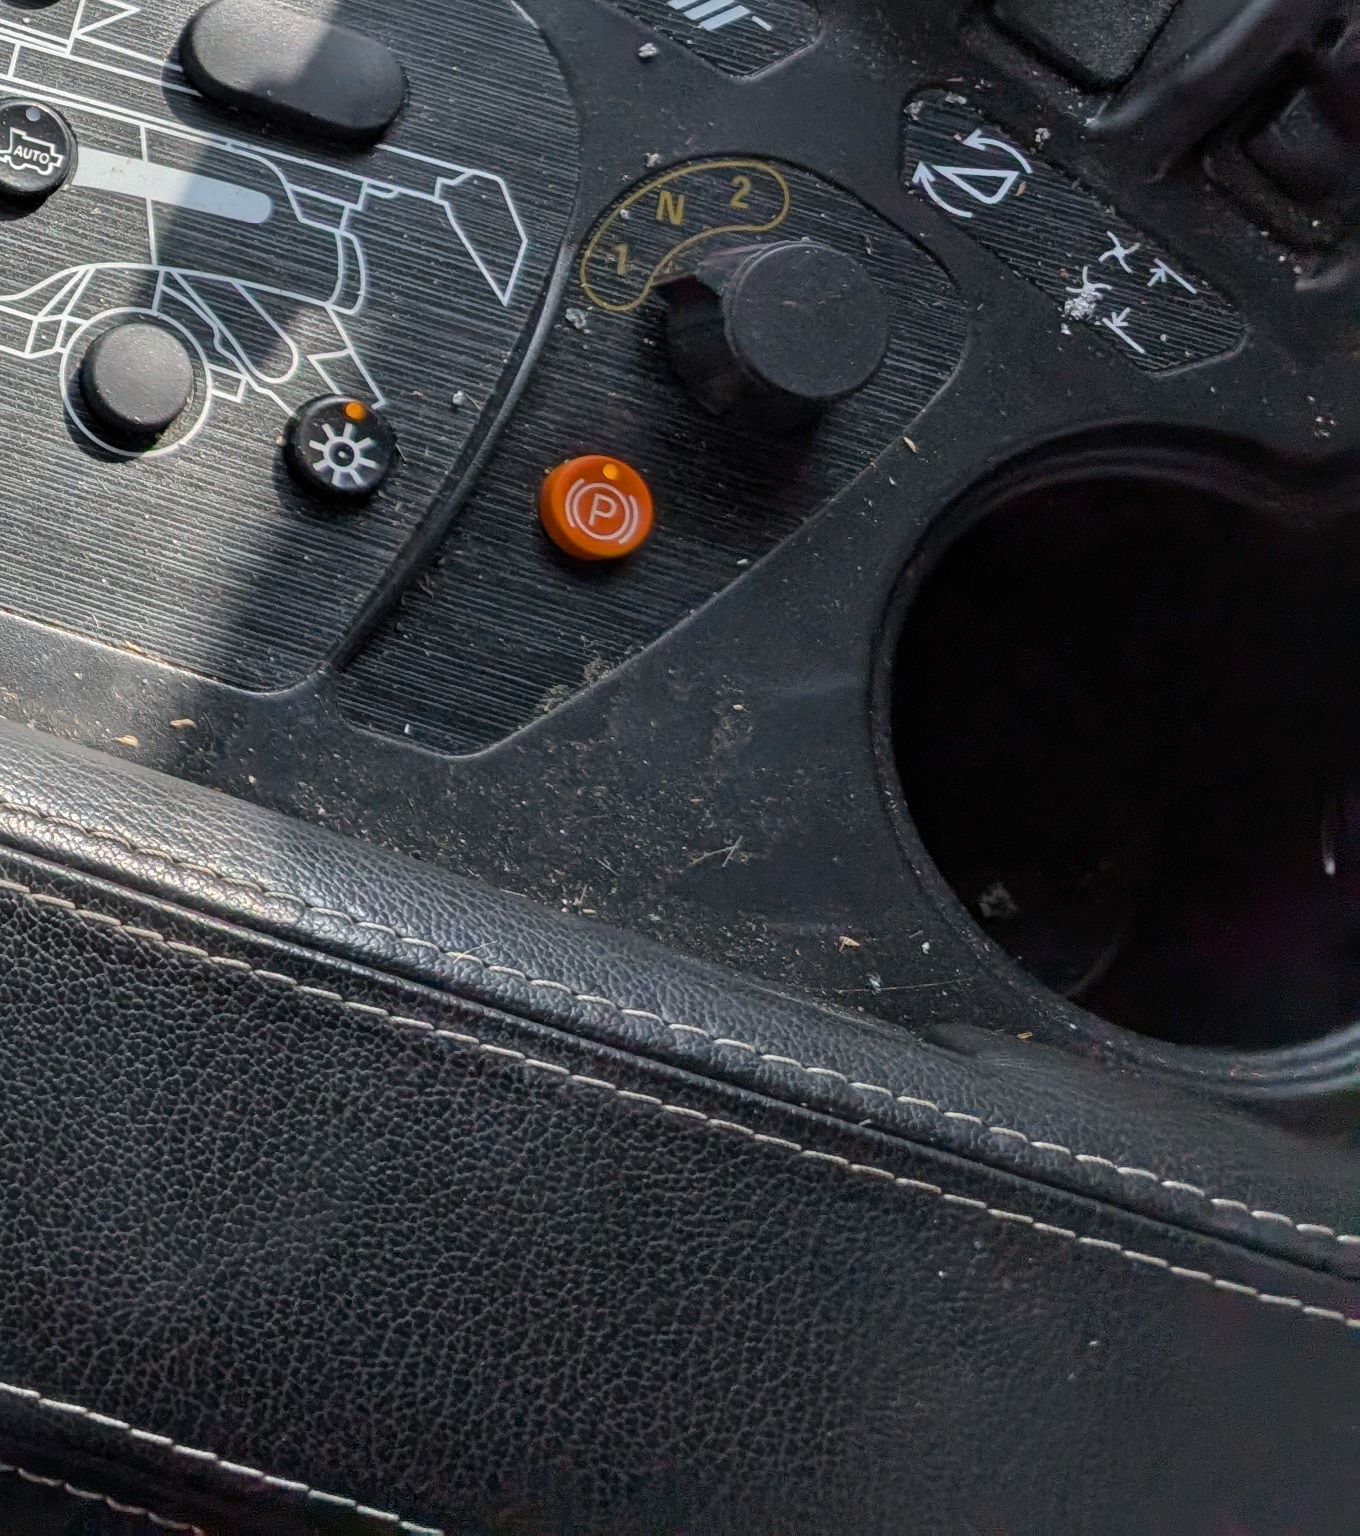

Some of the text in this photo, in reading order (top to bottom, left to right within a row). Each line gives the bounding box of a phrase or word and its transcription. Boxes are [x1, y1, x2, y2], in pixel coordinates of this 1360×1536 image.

[12, 145, 50, 165] AUTO
[615, 175, 752, 276] 1 N 2
[588, 493, 618, 526] P
